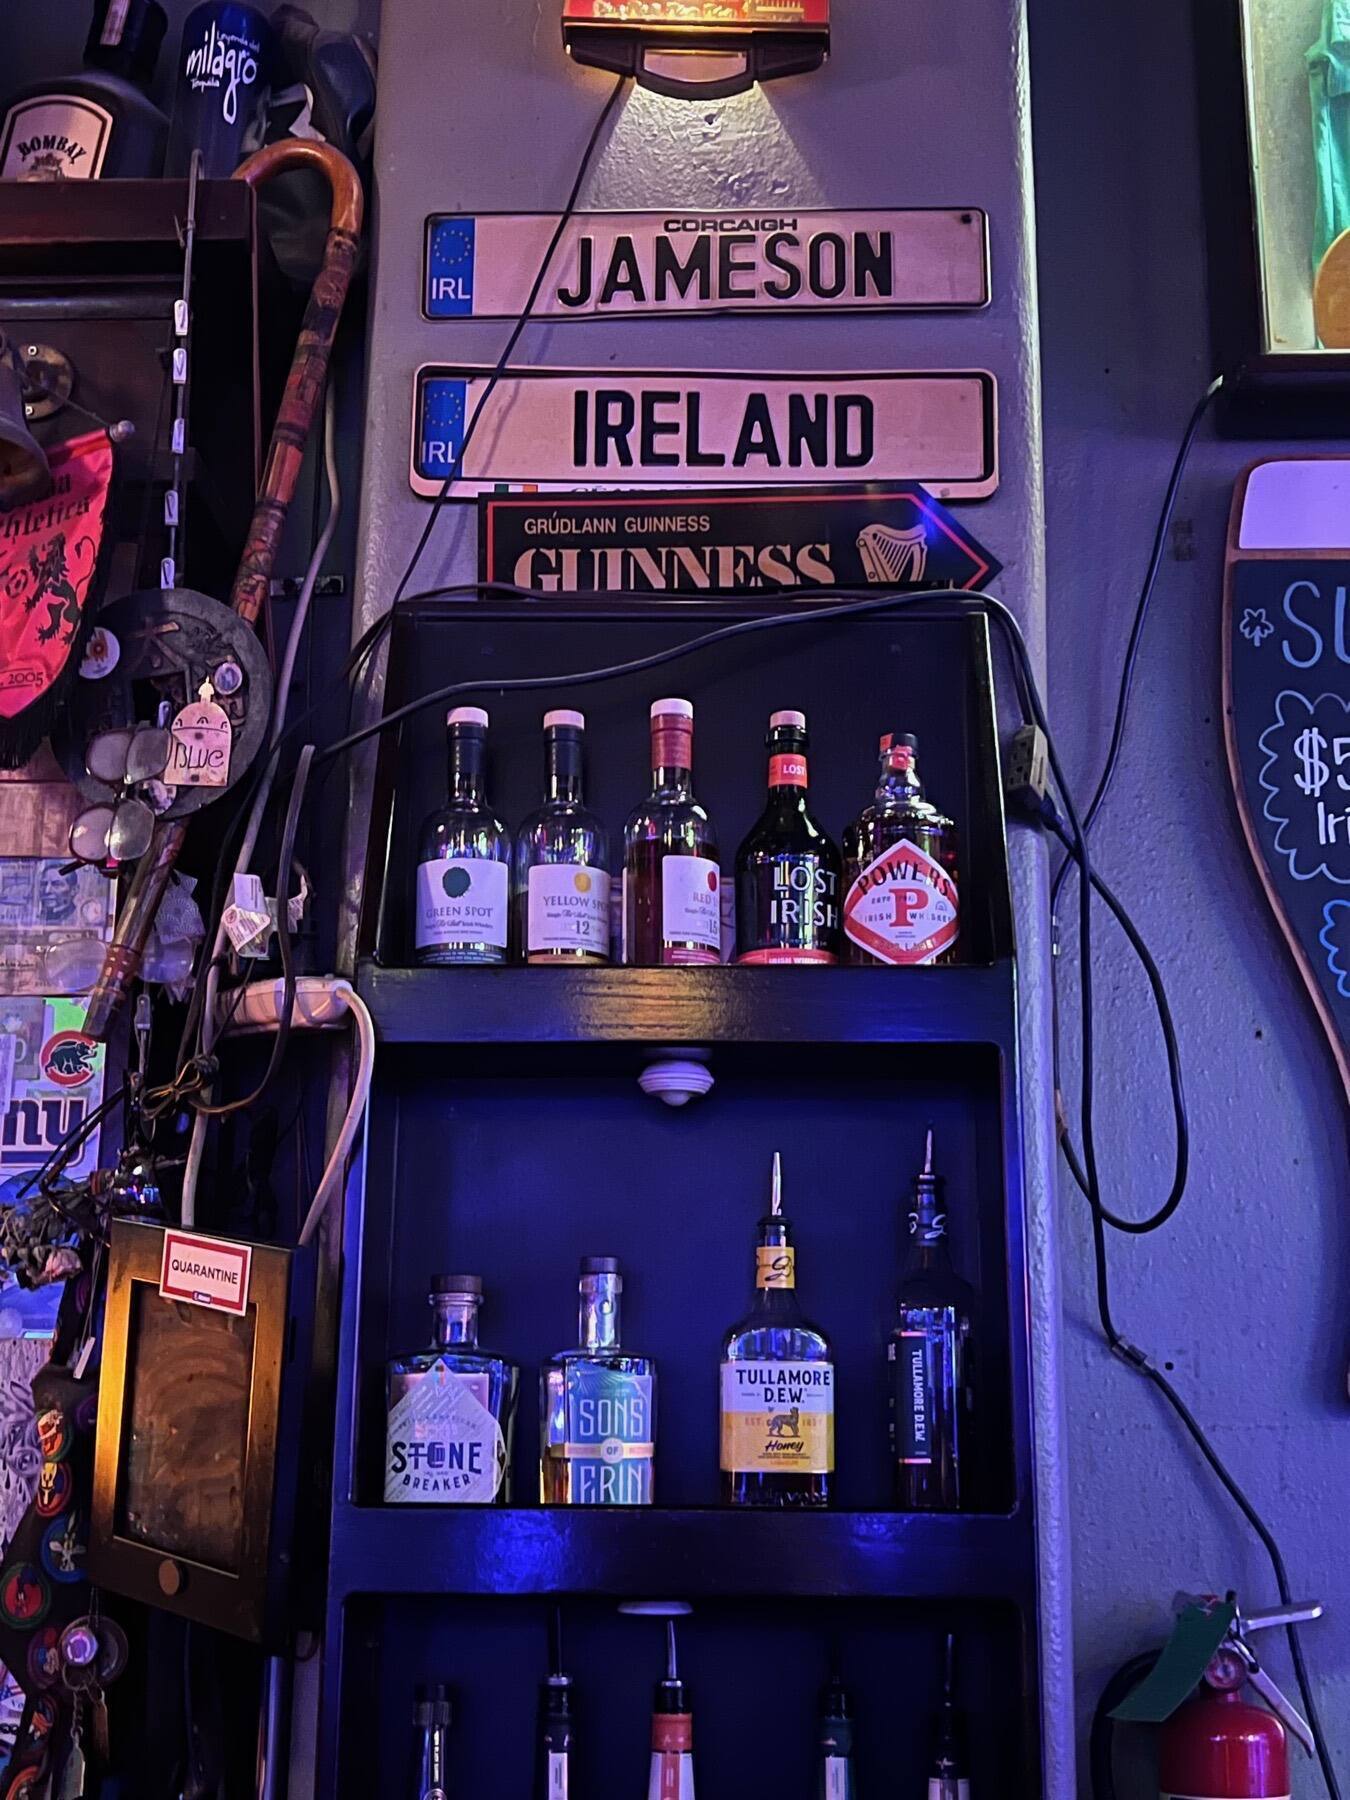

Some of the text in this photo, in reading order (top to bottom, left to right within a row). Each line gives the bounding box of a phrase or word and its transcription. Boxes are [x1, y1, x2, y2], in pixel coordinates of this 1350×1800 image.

[185, 20, 257, 125] milagro
[16, 134, 87, 165] BOMBAY
[663, 218, 798, 232] CORCAIGH
[556, 231, 893, 307] JAMESON
[431, 276, 472, 300] IRL
[573, 389, 874, 468] IRELAND
[421, 440, 456, 464] IRL
[523, 510, 711, 534] GRÚDLANN GUINNESS
[513, 543, 836, 591] GUINNESS
[8, 671, 44, 687] 2005
[782, 763, 806, 775] LOST
[773, 866, 837, 896] LOST
[857, 860, 951, 896] POWERS
[425, 906, 494, 919] GREEN SPOT
[543, 896, 590, 907] YELLOW
[770, 899, 838, 930] IRISH
[888, 887, 929, 928] P
[576, 920, 590, 935] 12
[171, 1258, 239, 1285] QUARANTINE
[735, 1368, 831, 1386] TULLAMORE
[911, 1349, 925, 1412] TULLAMORE
[579, 1397, 644, 1438] SONS
[390, 1440, 483, 1475] STONE
[606, 1445, 619, 1456] OF
[764, 1440, 805, 1453] Honey
[402, 1473, 472, 1491] BREAKER
[580, 1462, 643, 1504] ERIN
